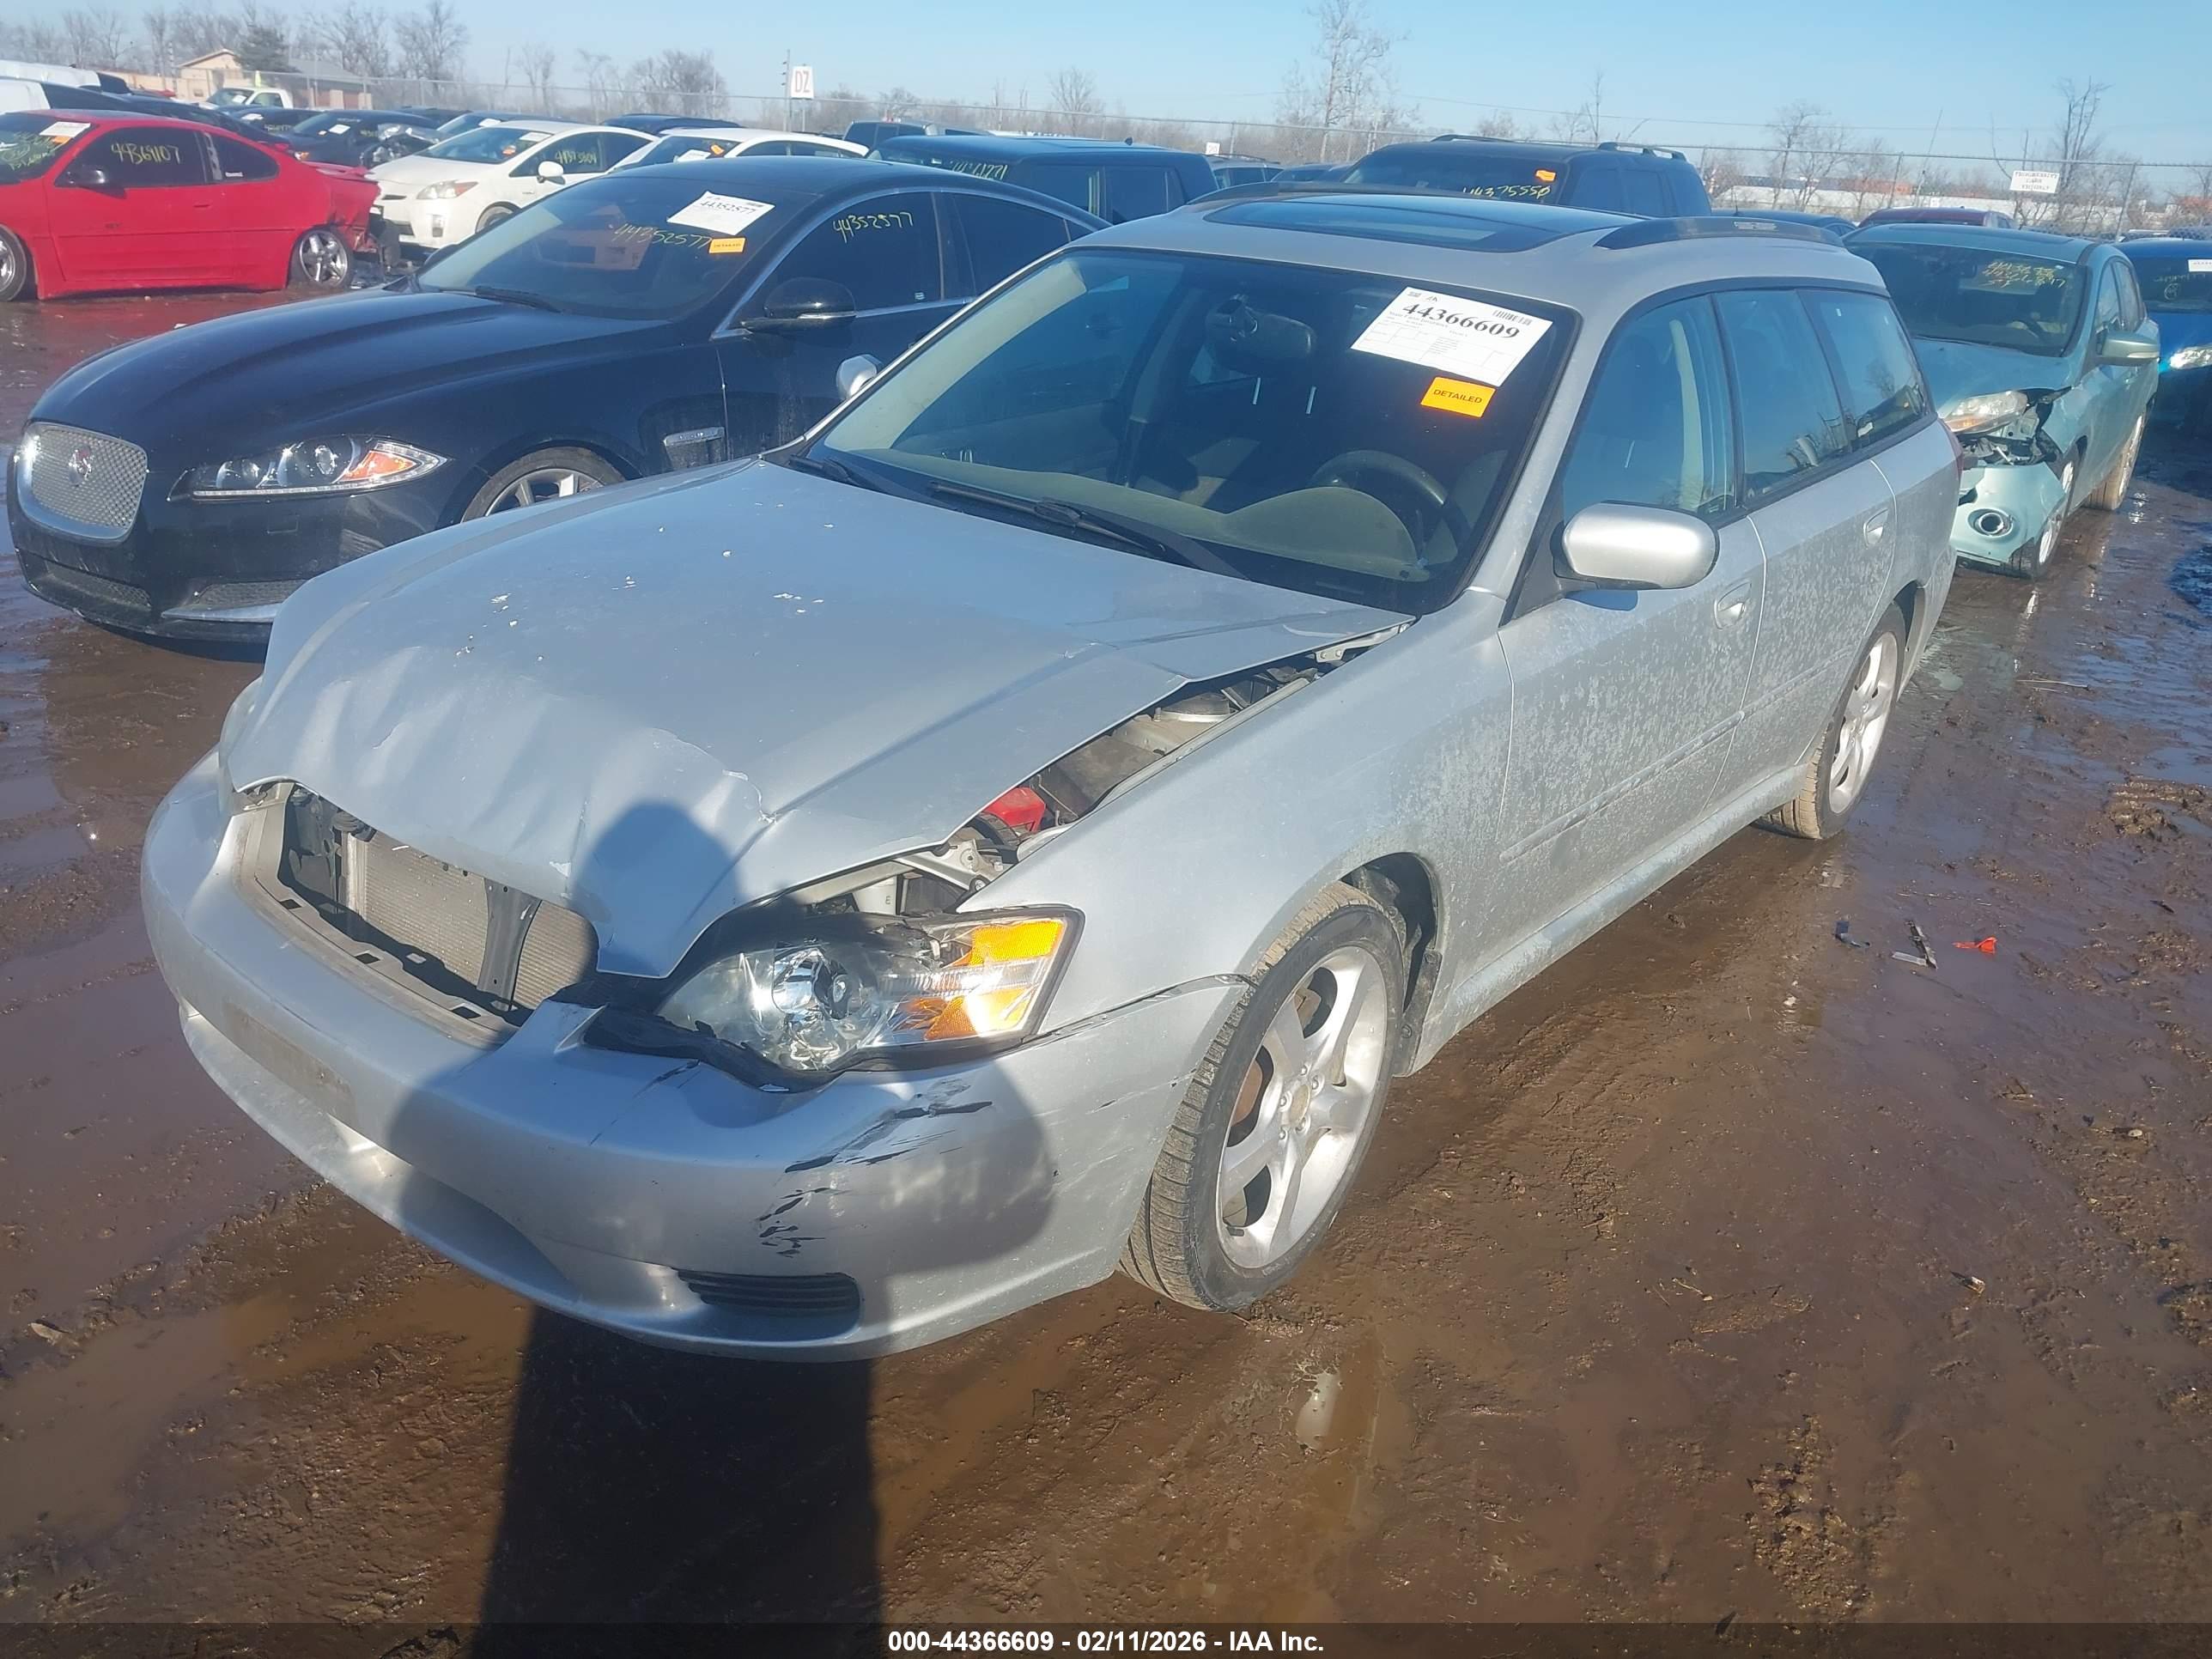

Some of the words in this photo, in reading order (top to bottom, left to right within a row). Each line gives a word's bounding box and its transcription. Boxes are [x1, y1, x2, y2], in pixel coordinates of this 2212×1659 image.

[795, 70, 811, 93] DZ
[614, 222, 713, 249] 44352577
[832, 211, 913, 243] 44352577
[1402, 303, 1520, 339] 44366609
[1433, 389, 1482, 404] DETAILED
